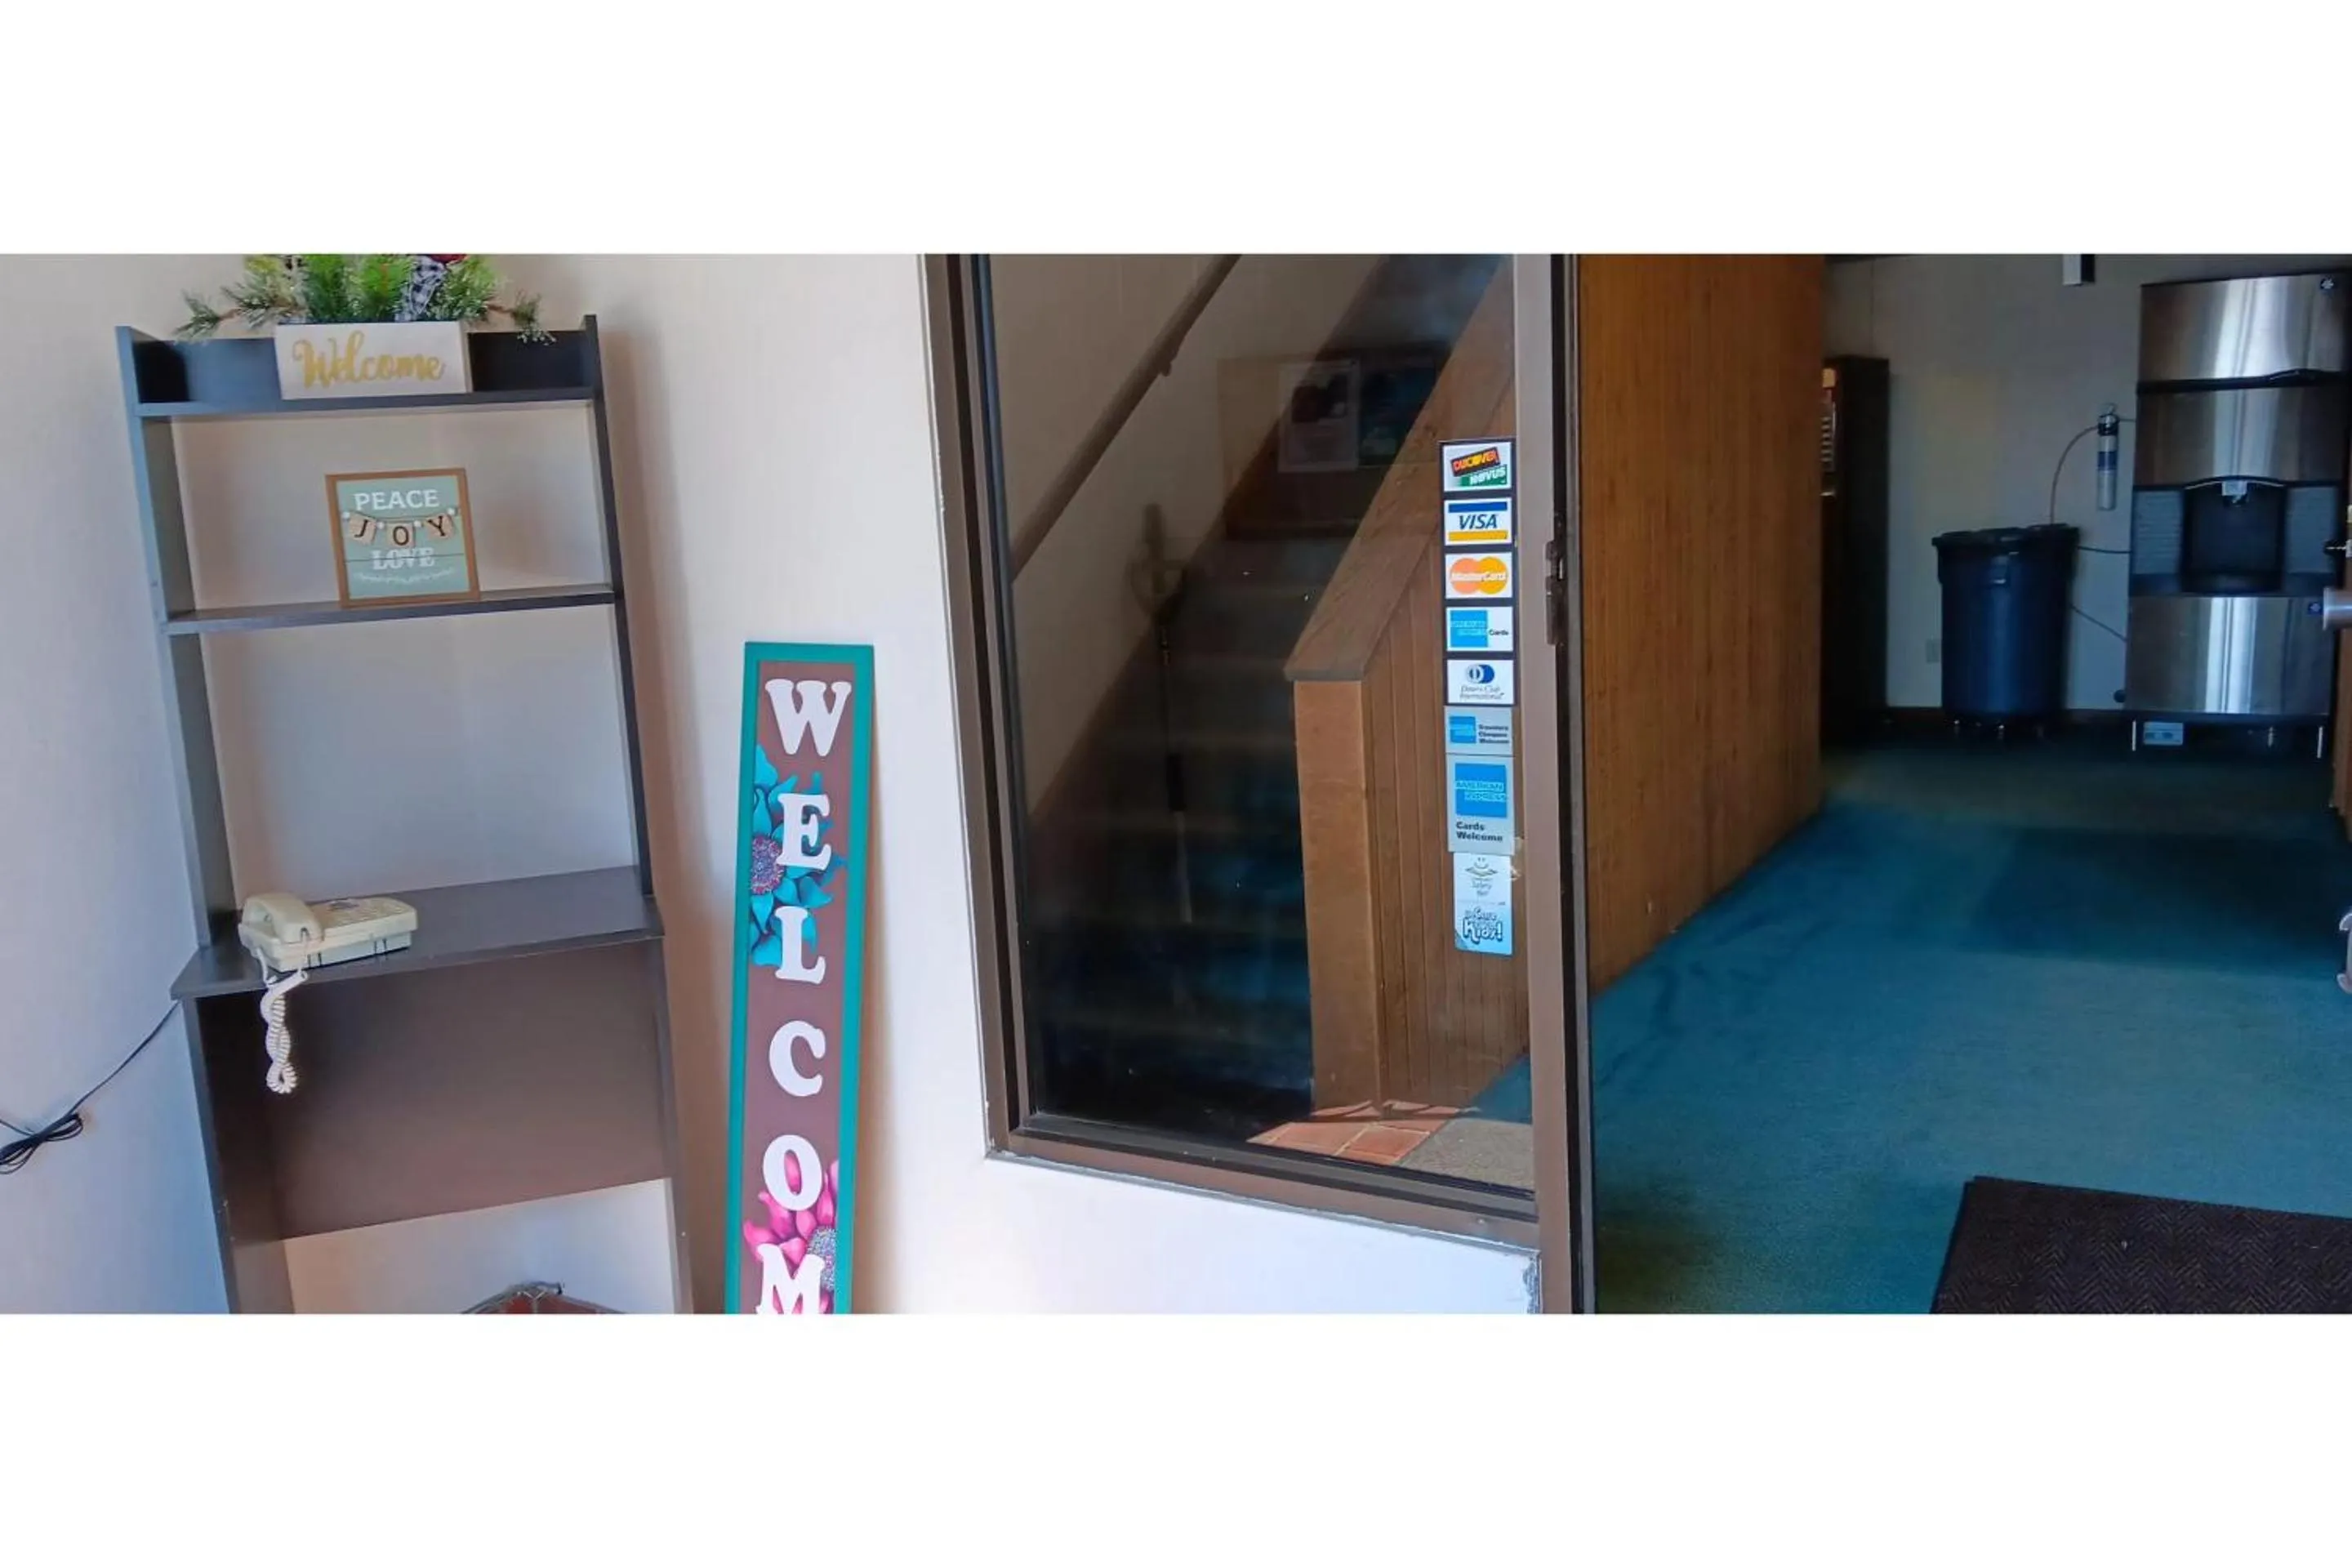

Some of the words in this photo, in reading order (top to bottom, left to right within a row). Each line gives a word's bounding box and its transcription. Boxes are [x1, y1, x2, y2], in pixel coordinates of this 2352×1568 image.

[293, 331, 445, 389] Welcome
[354, 489, 440, 510] PEACE
[354, 514, 448, 546] JOY
[1459, 513, 1499, 531] VISA
[371, 546, 435, 571] LOVE
[1456, 821, 1485, 831] Cards
[1456, 831, 1503, 842] Welcome
